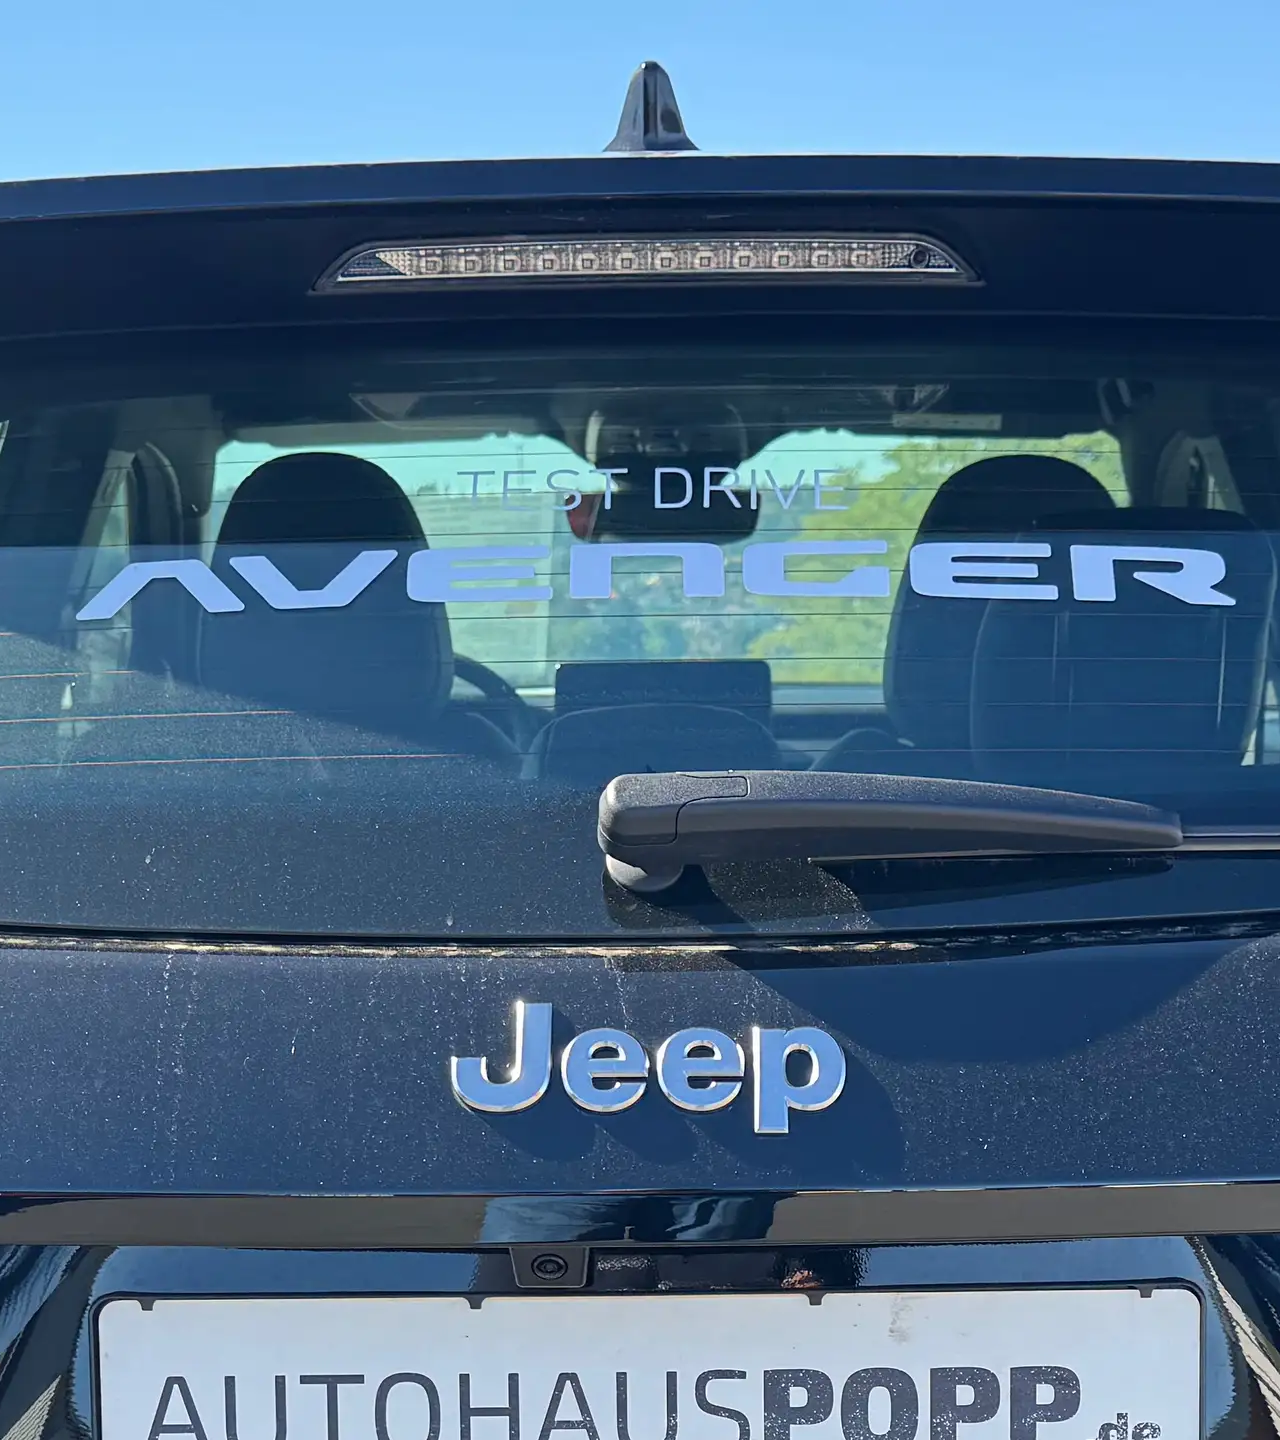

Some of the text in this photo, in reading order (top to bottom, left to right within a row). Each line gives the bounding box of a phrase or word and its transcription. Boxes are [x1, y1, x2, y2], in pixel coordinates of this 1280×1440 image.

[456, 466, 850, 512] TEST DRIVE
[75, 539, 1238, 621] AVENGER
[450, 1000, 847, 1135] Jeep
